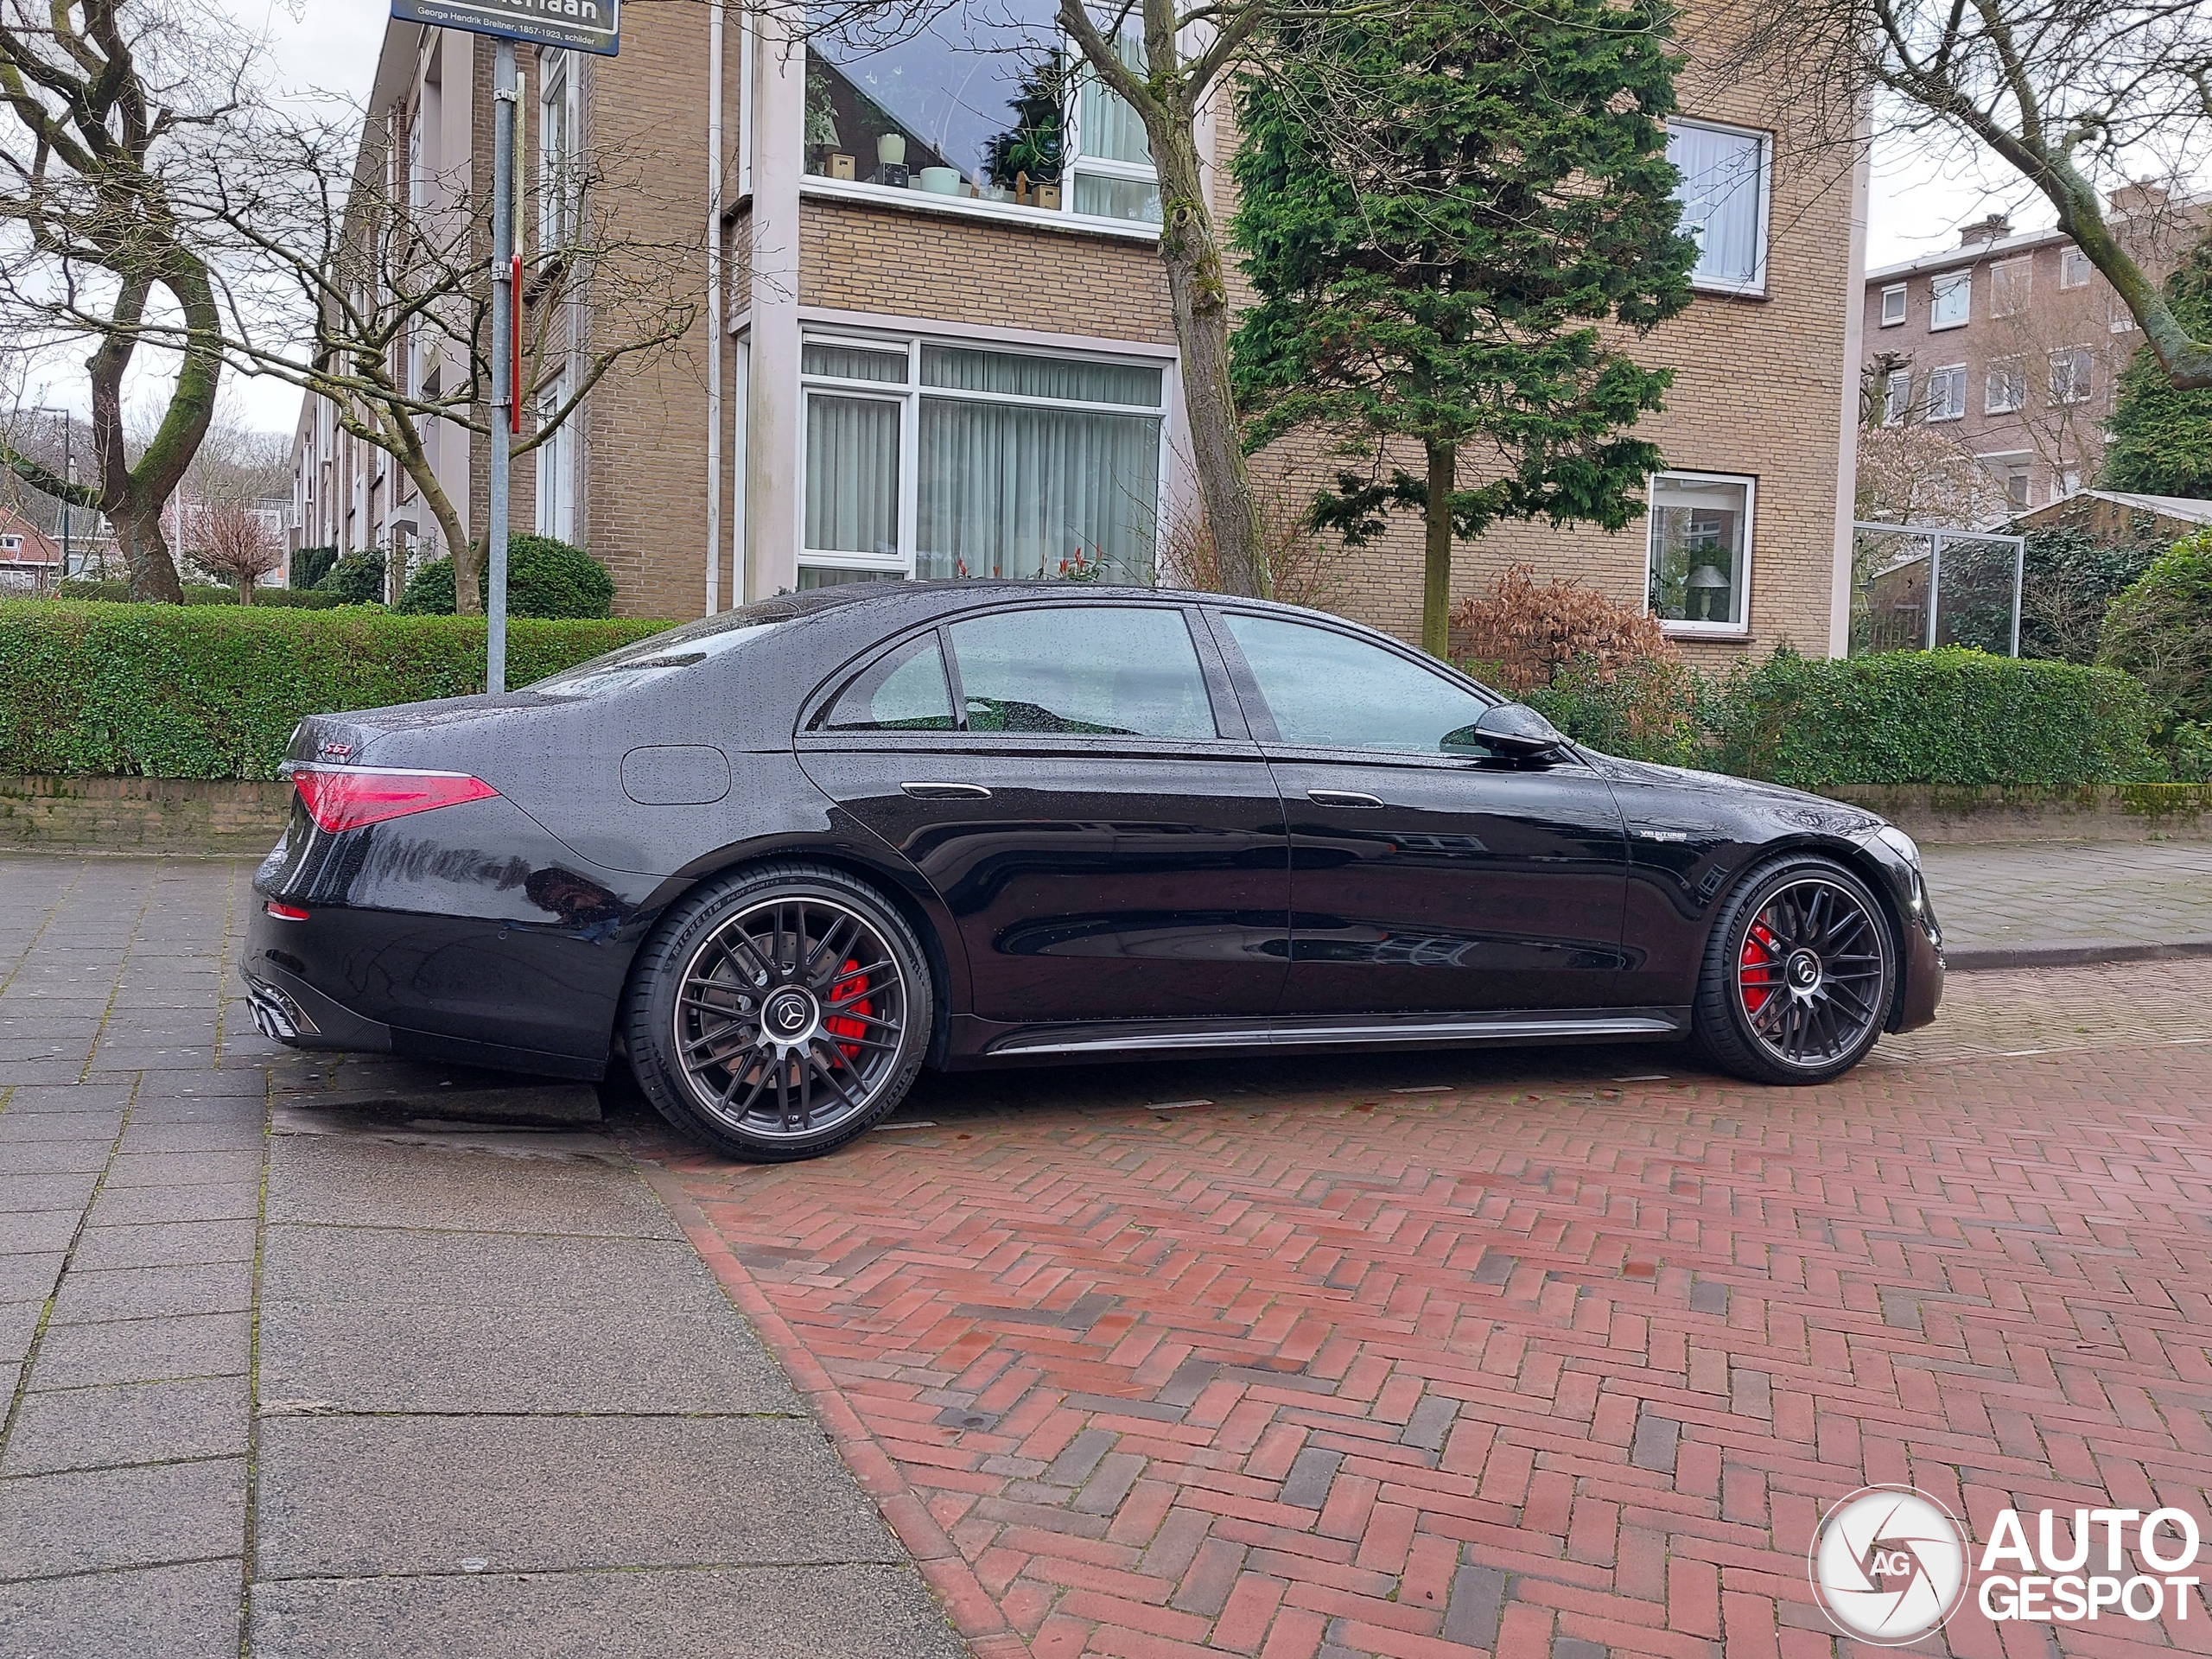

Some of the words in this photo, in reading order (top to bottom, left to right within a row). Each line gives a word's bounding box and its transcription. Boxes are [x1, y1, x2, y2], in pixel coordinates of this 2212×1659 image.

[417, 6, 448, 20] George
[450, 12, 482, 25] Hendrik
[483, 17, 517, 32] Breitner,
[518, 24, 563, 41] 1857-1923,
[564, 34, 595, 45] schilder
[671, 902, 723, 958] MICHELIN
[727, 890, 745, 903] PILOT
[1724, 905, 1745, 963] MICHELIN
[1746, 889, 1759, 904] PILOT
